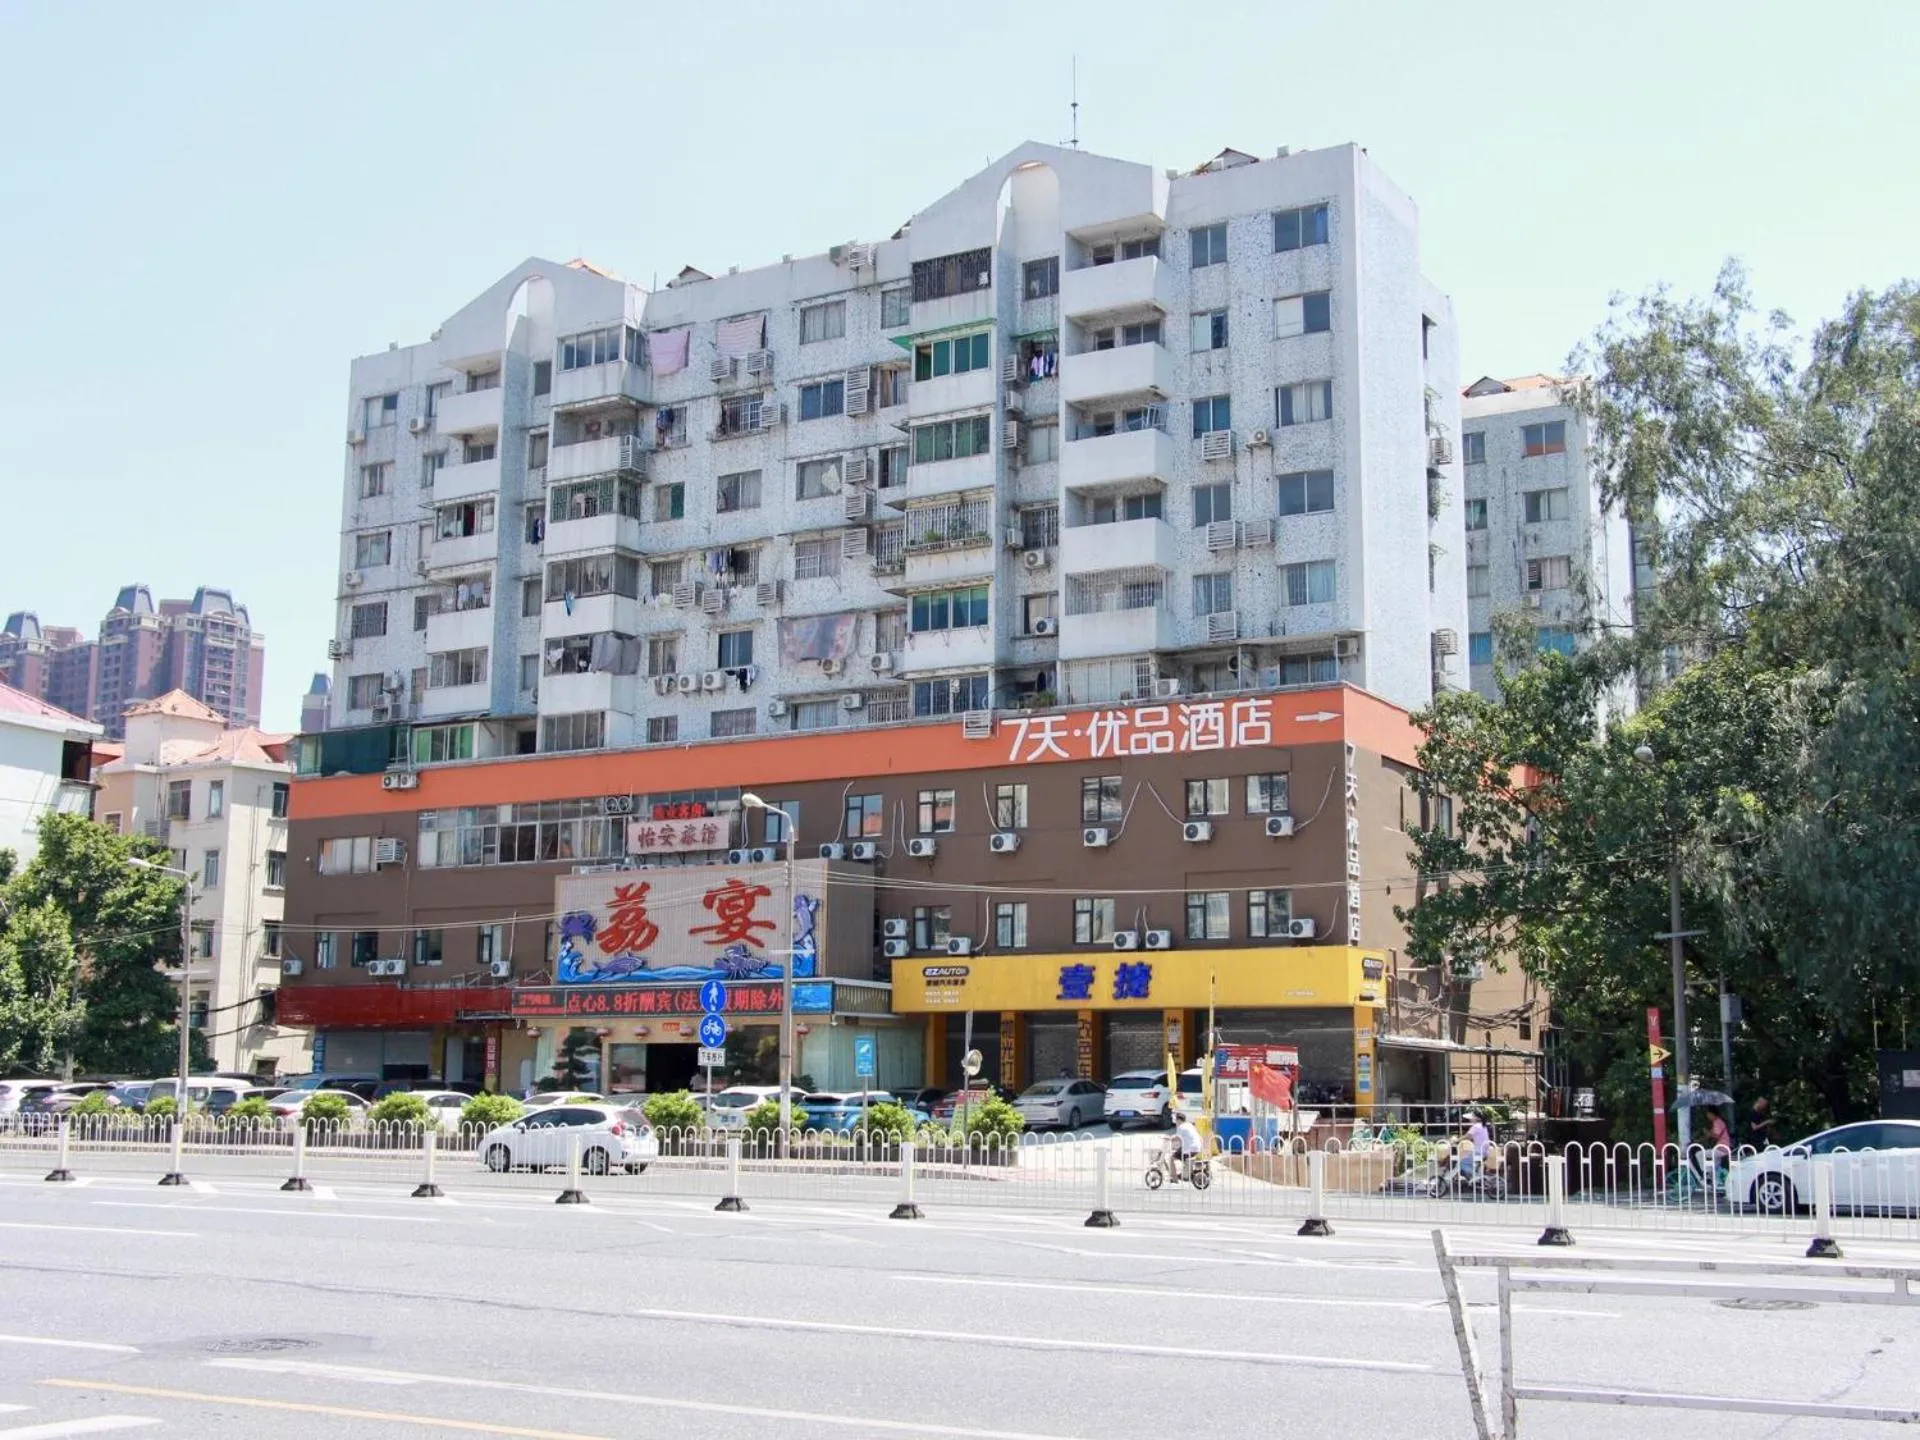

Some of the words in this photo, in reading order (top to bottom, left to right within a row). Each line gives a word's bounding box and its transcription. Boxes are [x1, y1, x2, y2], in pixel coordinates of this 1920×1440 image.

[1001, 698, 1273, 762] 7天·优品酒店
